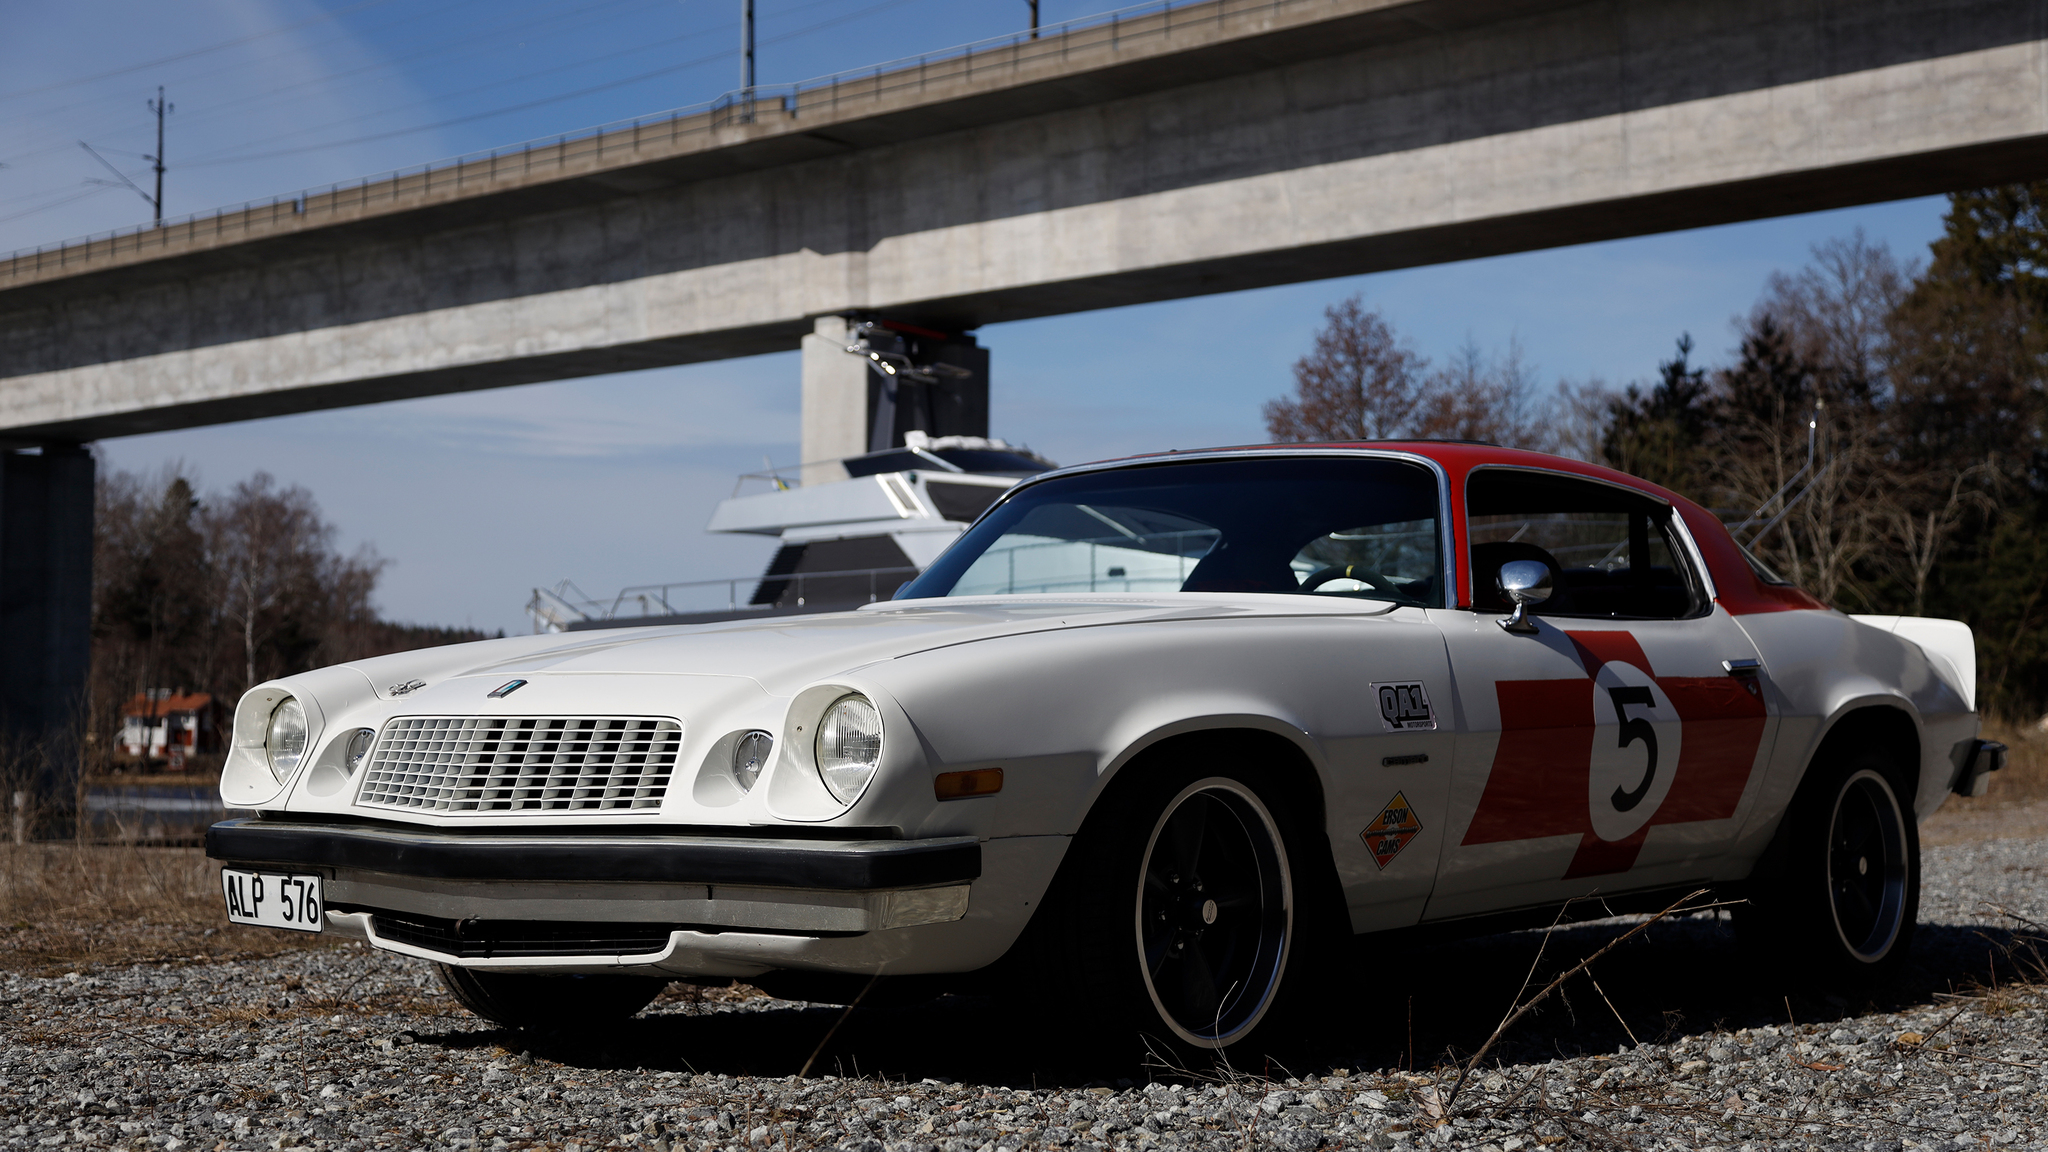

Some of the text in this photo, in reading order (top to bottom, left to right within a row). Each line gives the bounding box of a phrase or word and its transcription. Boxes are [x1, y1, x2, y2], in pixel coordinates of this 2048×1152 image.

[1379, 685, 1430, 728] QA1
[1608, 686, 1658, 812] 5
[1383, 808, 1408, 825] ERSON
[1377, 839, 1400, 855] CAMS
[228, 875, 318, 924] ALP 576
